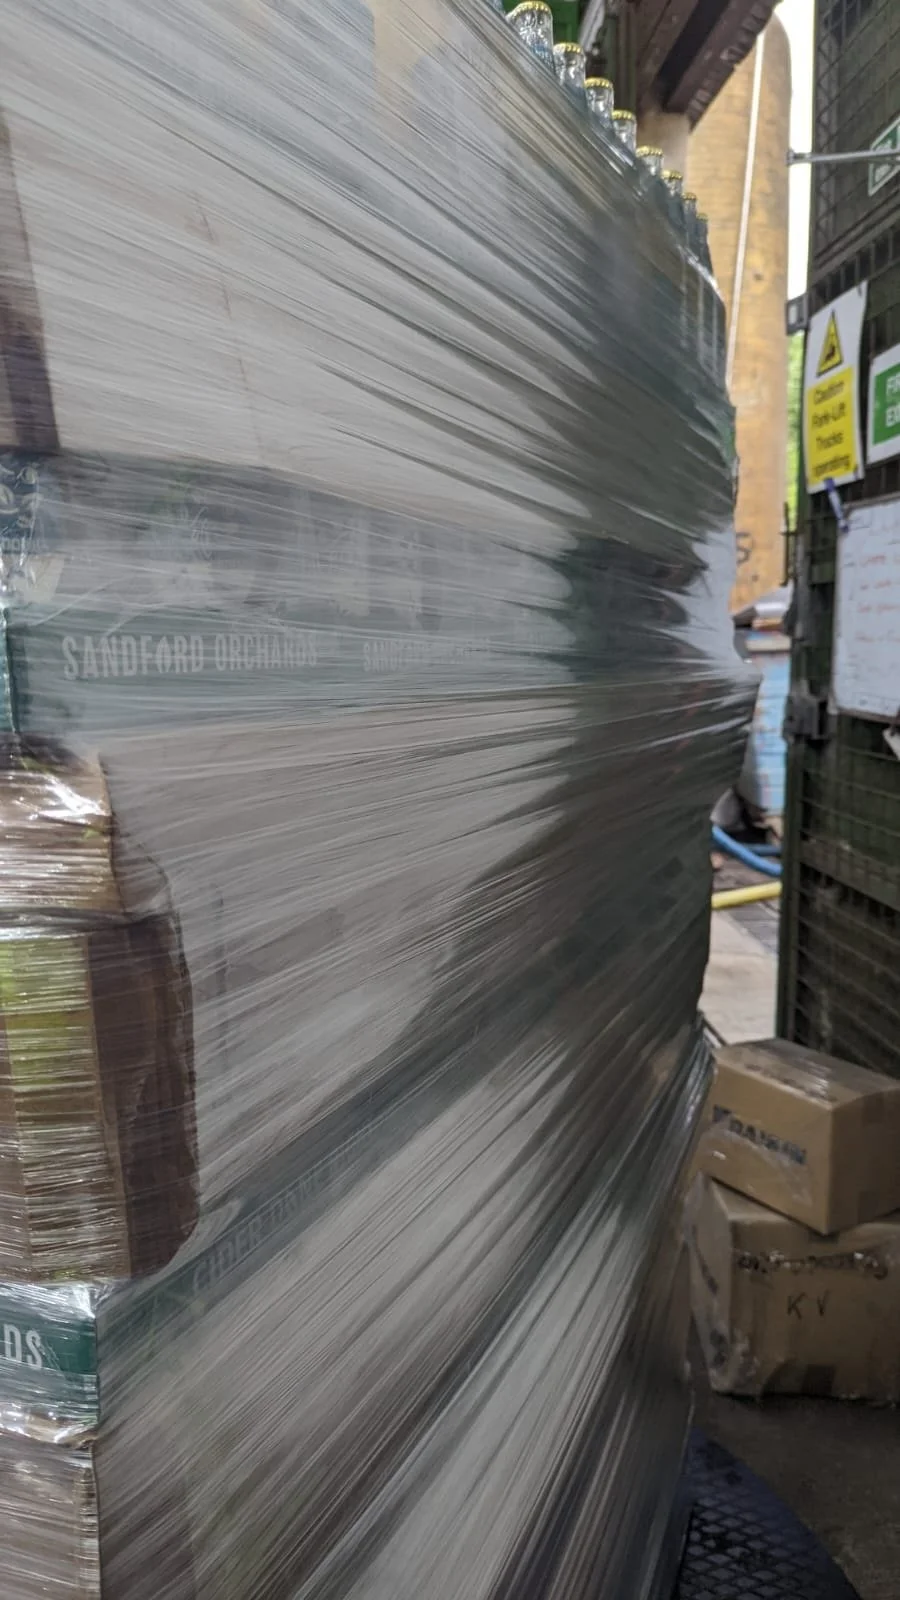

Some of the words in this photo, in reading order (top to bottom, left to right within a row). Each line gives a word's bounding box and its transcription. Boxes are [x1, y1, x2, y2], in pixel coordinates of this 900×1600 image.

[814, 380, 844, 405] Caution
[816, 430, 844, 451] Trucks
[62, 634, 204, 680] SANDFORD
[214, 631, 318, 671] ORCHARDS
